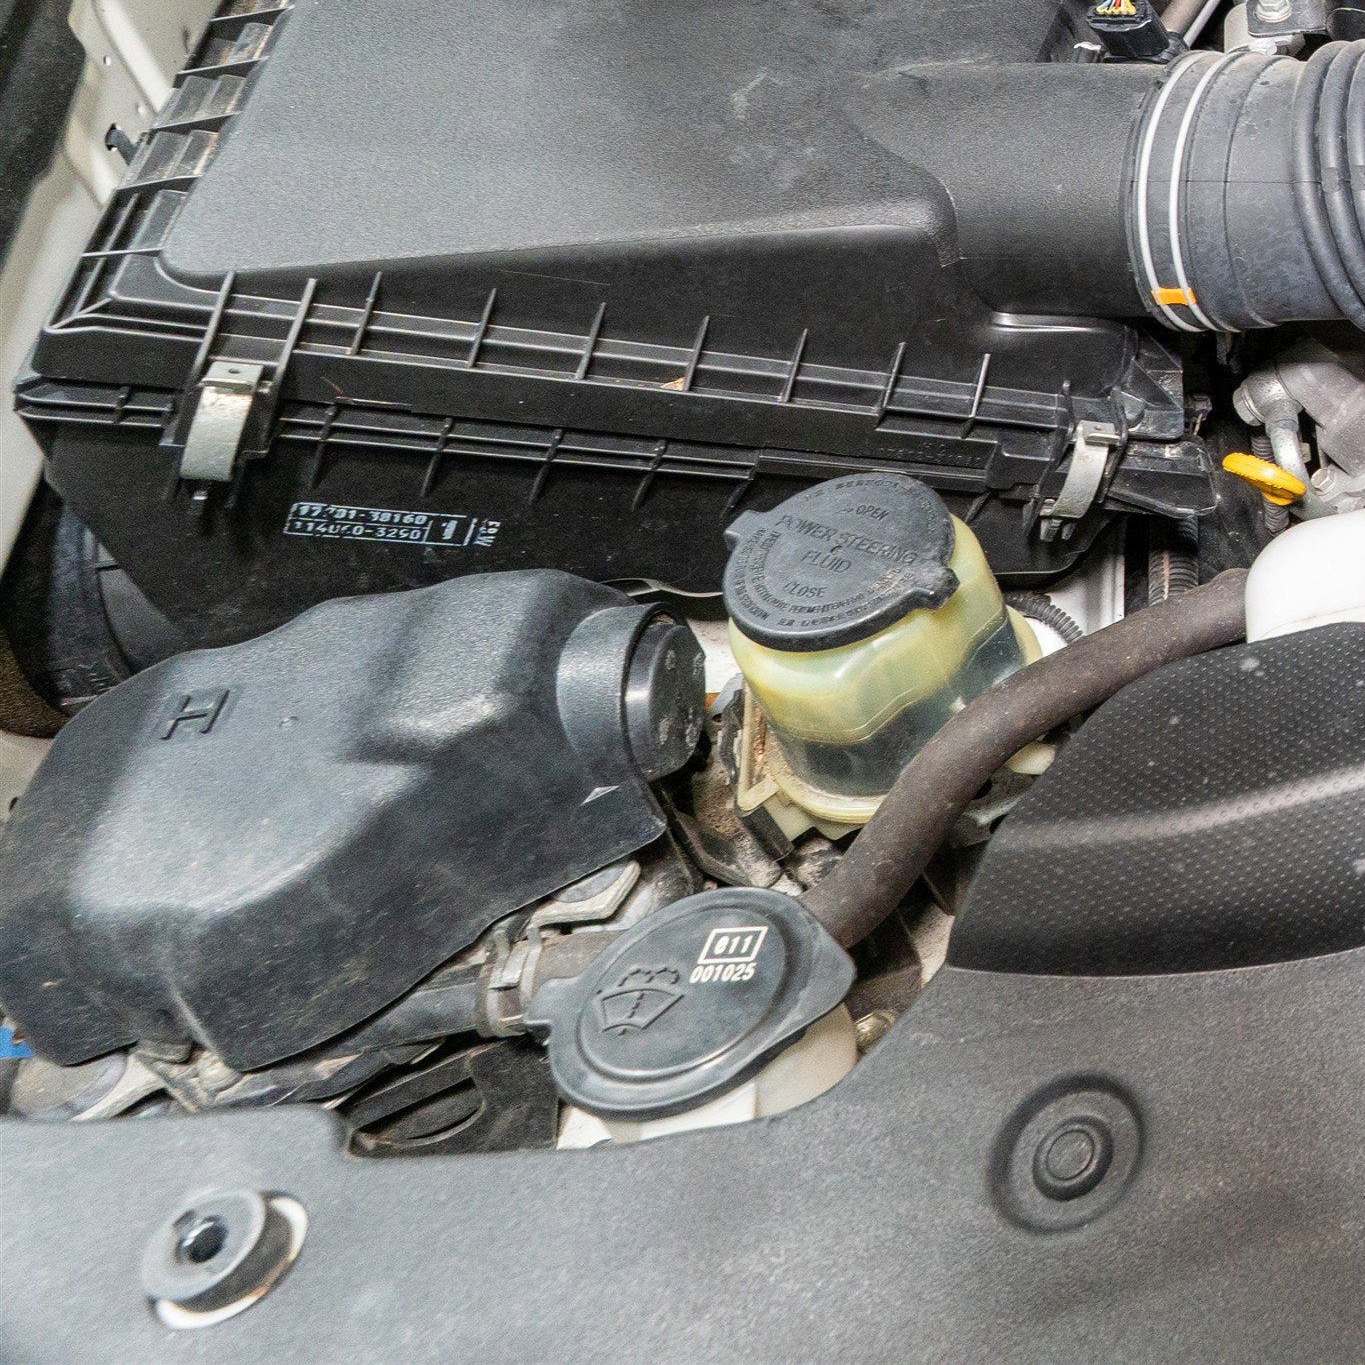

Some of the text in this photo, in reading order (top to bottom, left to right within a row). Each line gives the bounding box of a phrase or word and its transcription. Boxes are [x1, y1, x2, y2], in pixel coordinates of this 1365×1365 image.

[856, 503, 890, 521] OPEN
[775, 514, 918, 566] POWER STEERING
[800, 548, 852, 574] FLUID
[783, 580, 828, 598] CLOSE
[689, 962, 757, 984] 001025
